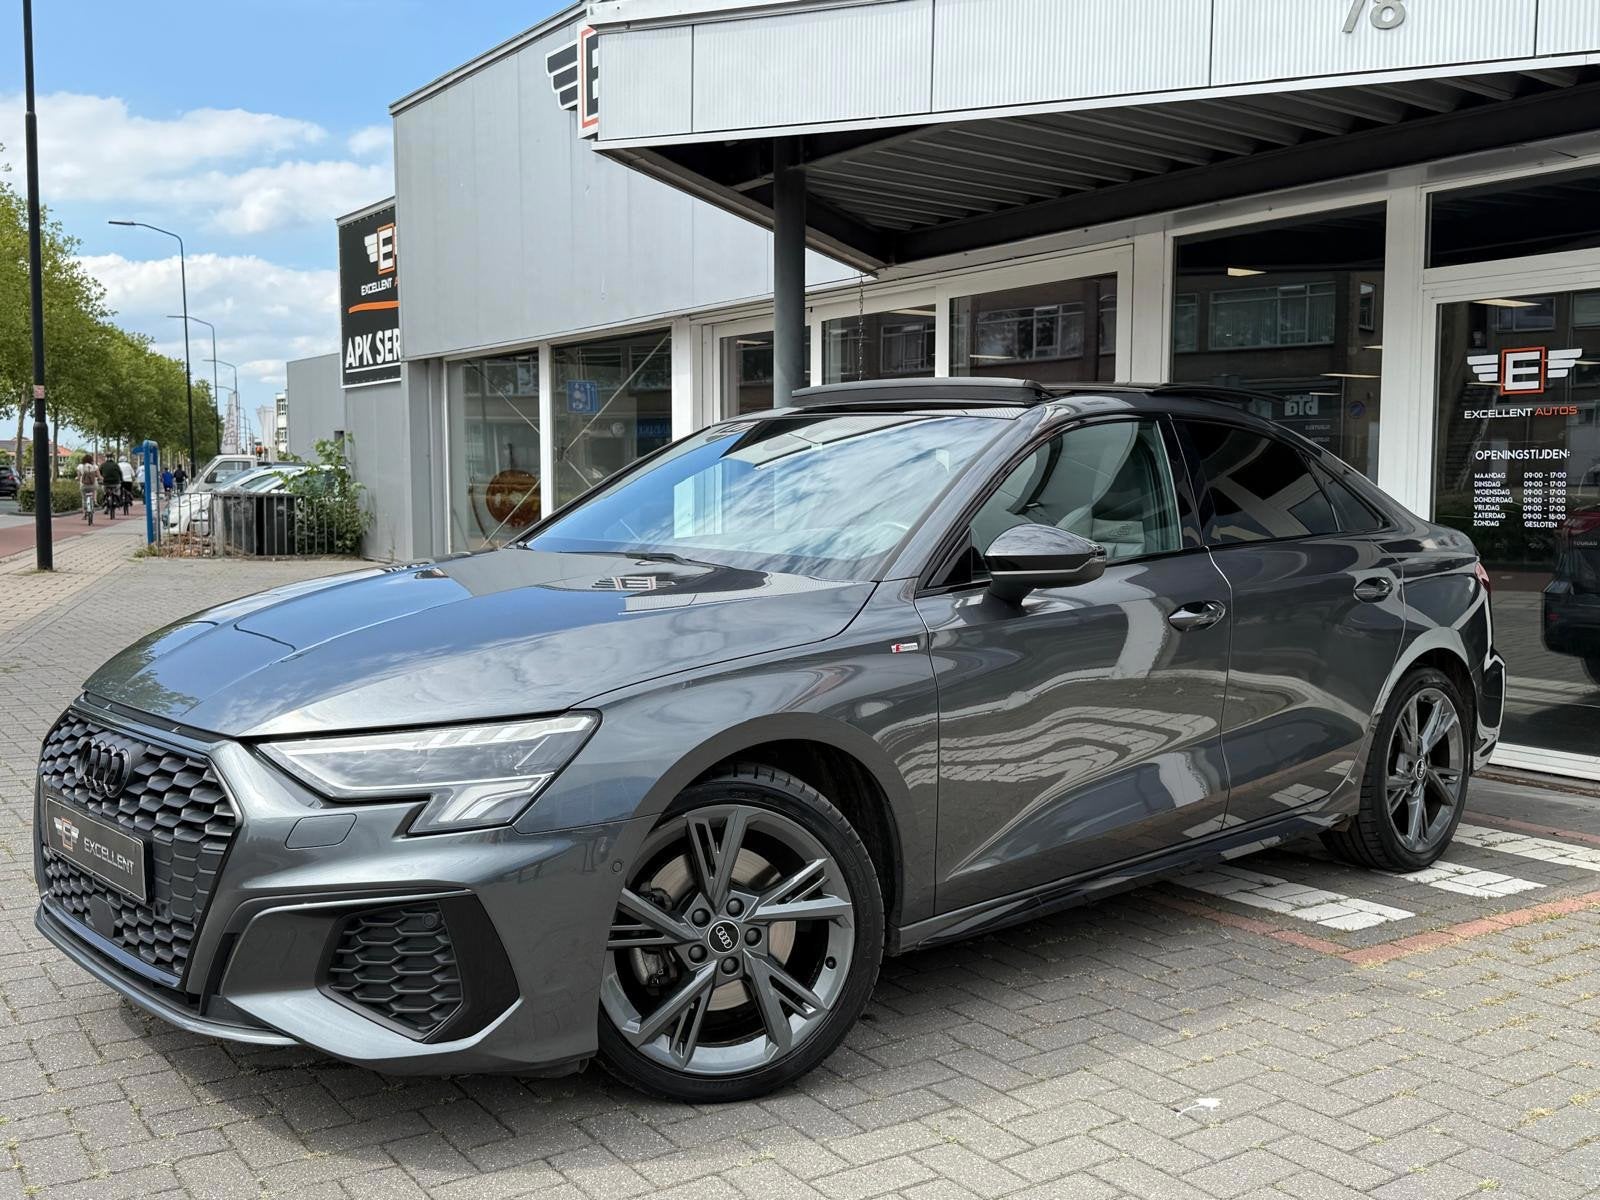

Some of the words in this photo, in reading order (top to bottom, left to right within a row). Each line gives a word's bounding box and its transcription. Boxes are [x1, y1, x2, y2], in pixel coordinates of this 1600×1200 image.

[361, 277, 393, 296] EXCELLENT
[345, 333, 373, 368] APK
[375, 327, 401, 366] SER
[1505, 351, 1541, 391] E
[1463, 408, 1533, 419] EXCELLENT
[1535, 406, 1578, 416] AUTOS
[1475, 449, 1571, 460] OPENINGSTIJDEN:
[83, 837, 135, 876] EXCELLENT
